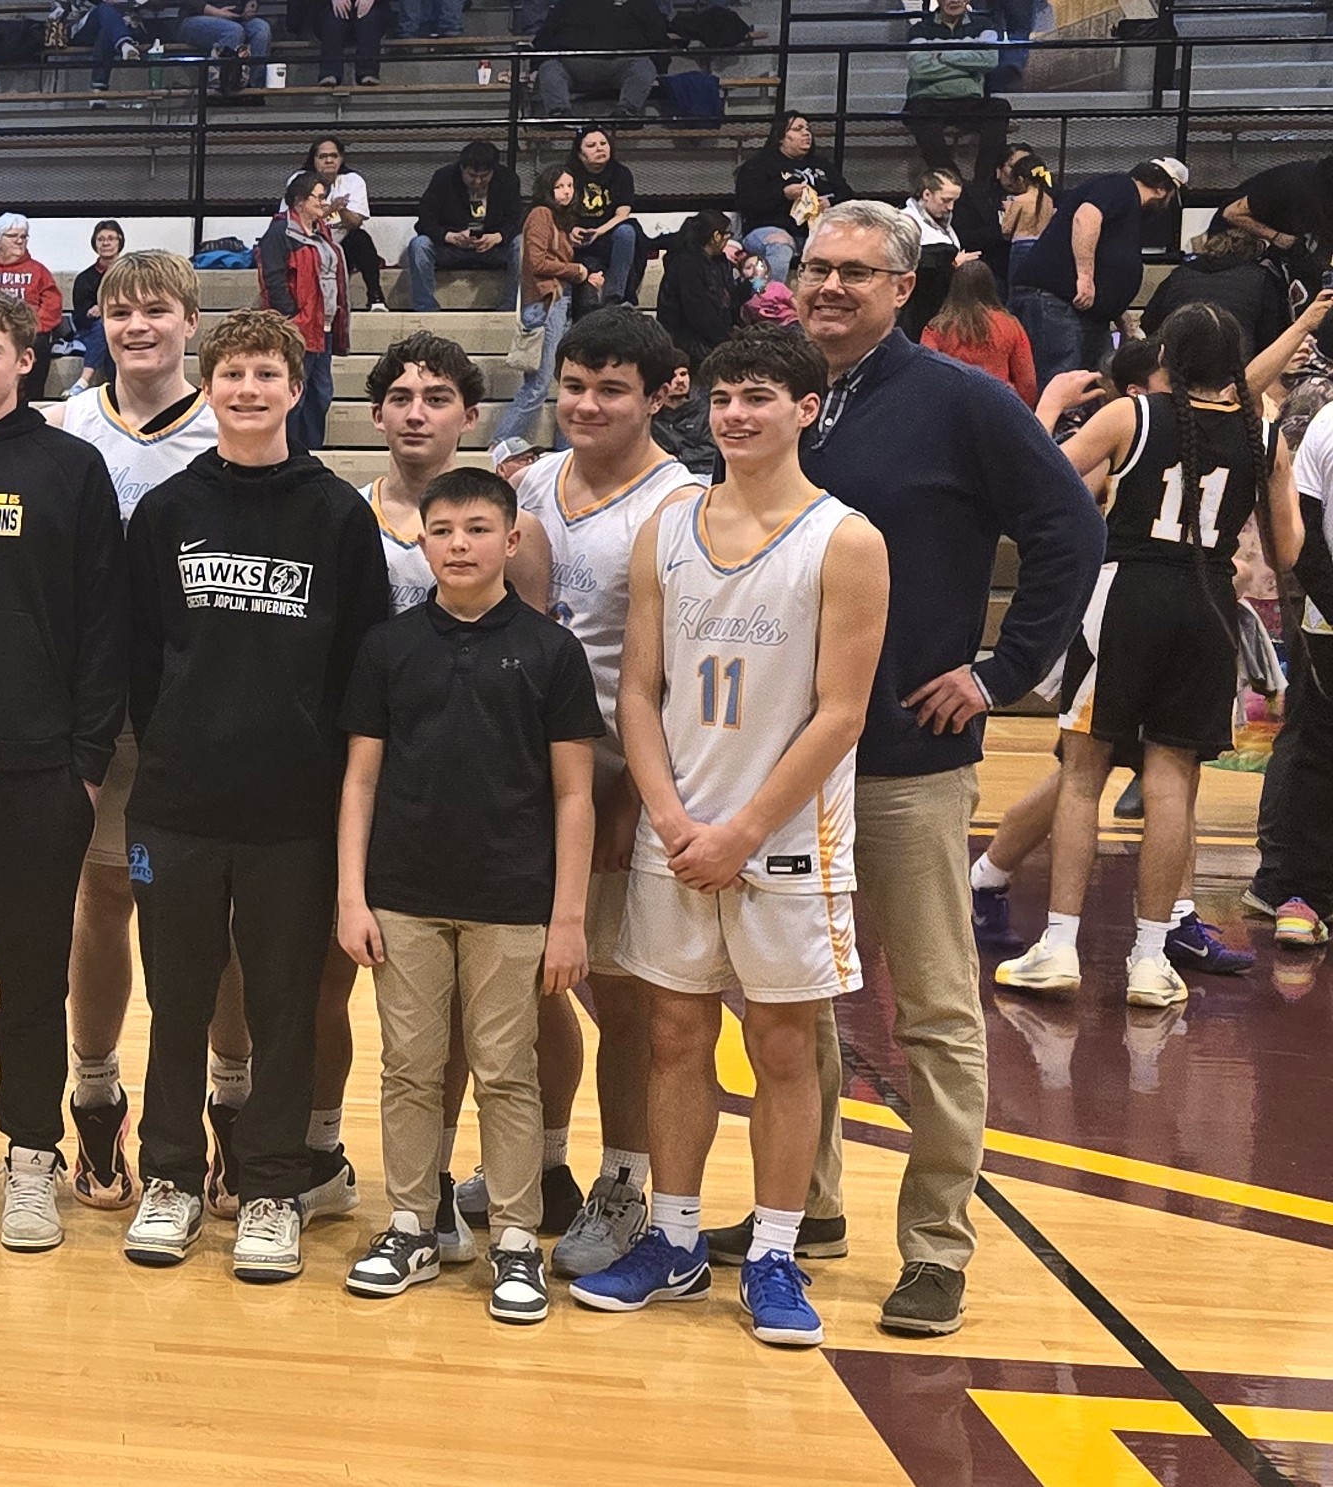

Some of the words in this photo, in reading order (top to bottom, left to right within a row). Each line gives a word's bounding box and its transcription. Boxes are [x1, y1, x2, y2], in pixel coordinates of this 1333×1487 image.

[1150, 461, 1230, 548] 11
[182, 562, 263, 586] HAWKS
[213, 594, 249, 611] JOPLIN.
[675, 596, 788, 646] Hawks
[697, 654, 745, 729] 11
